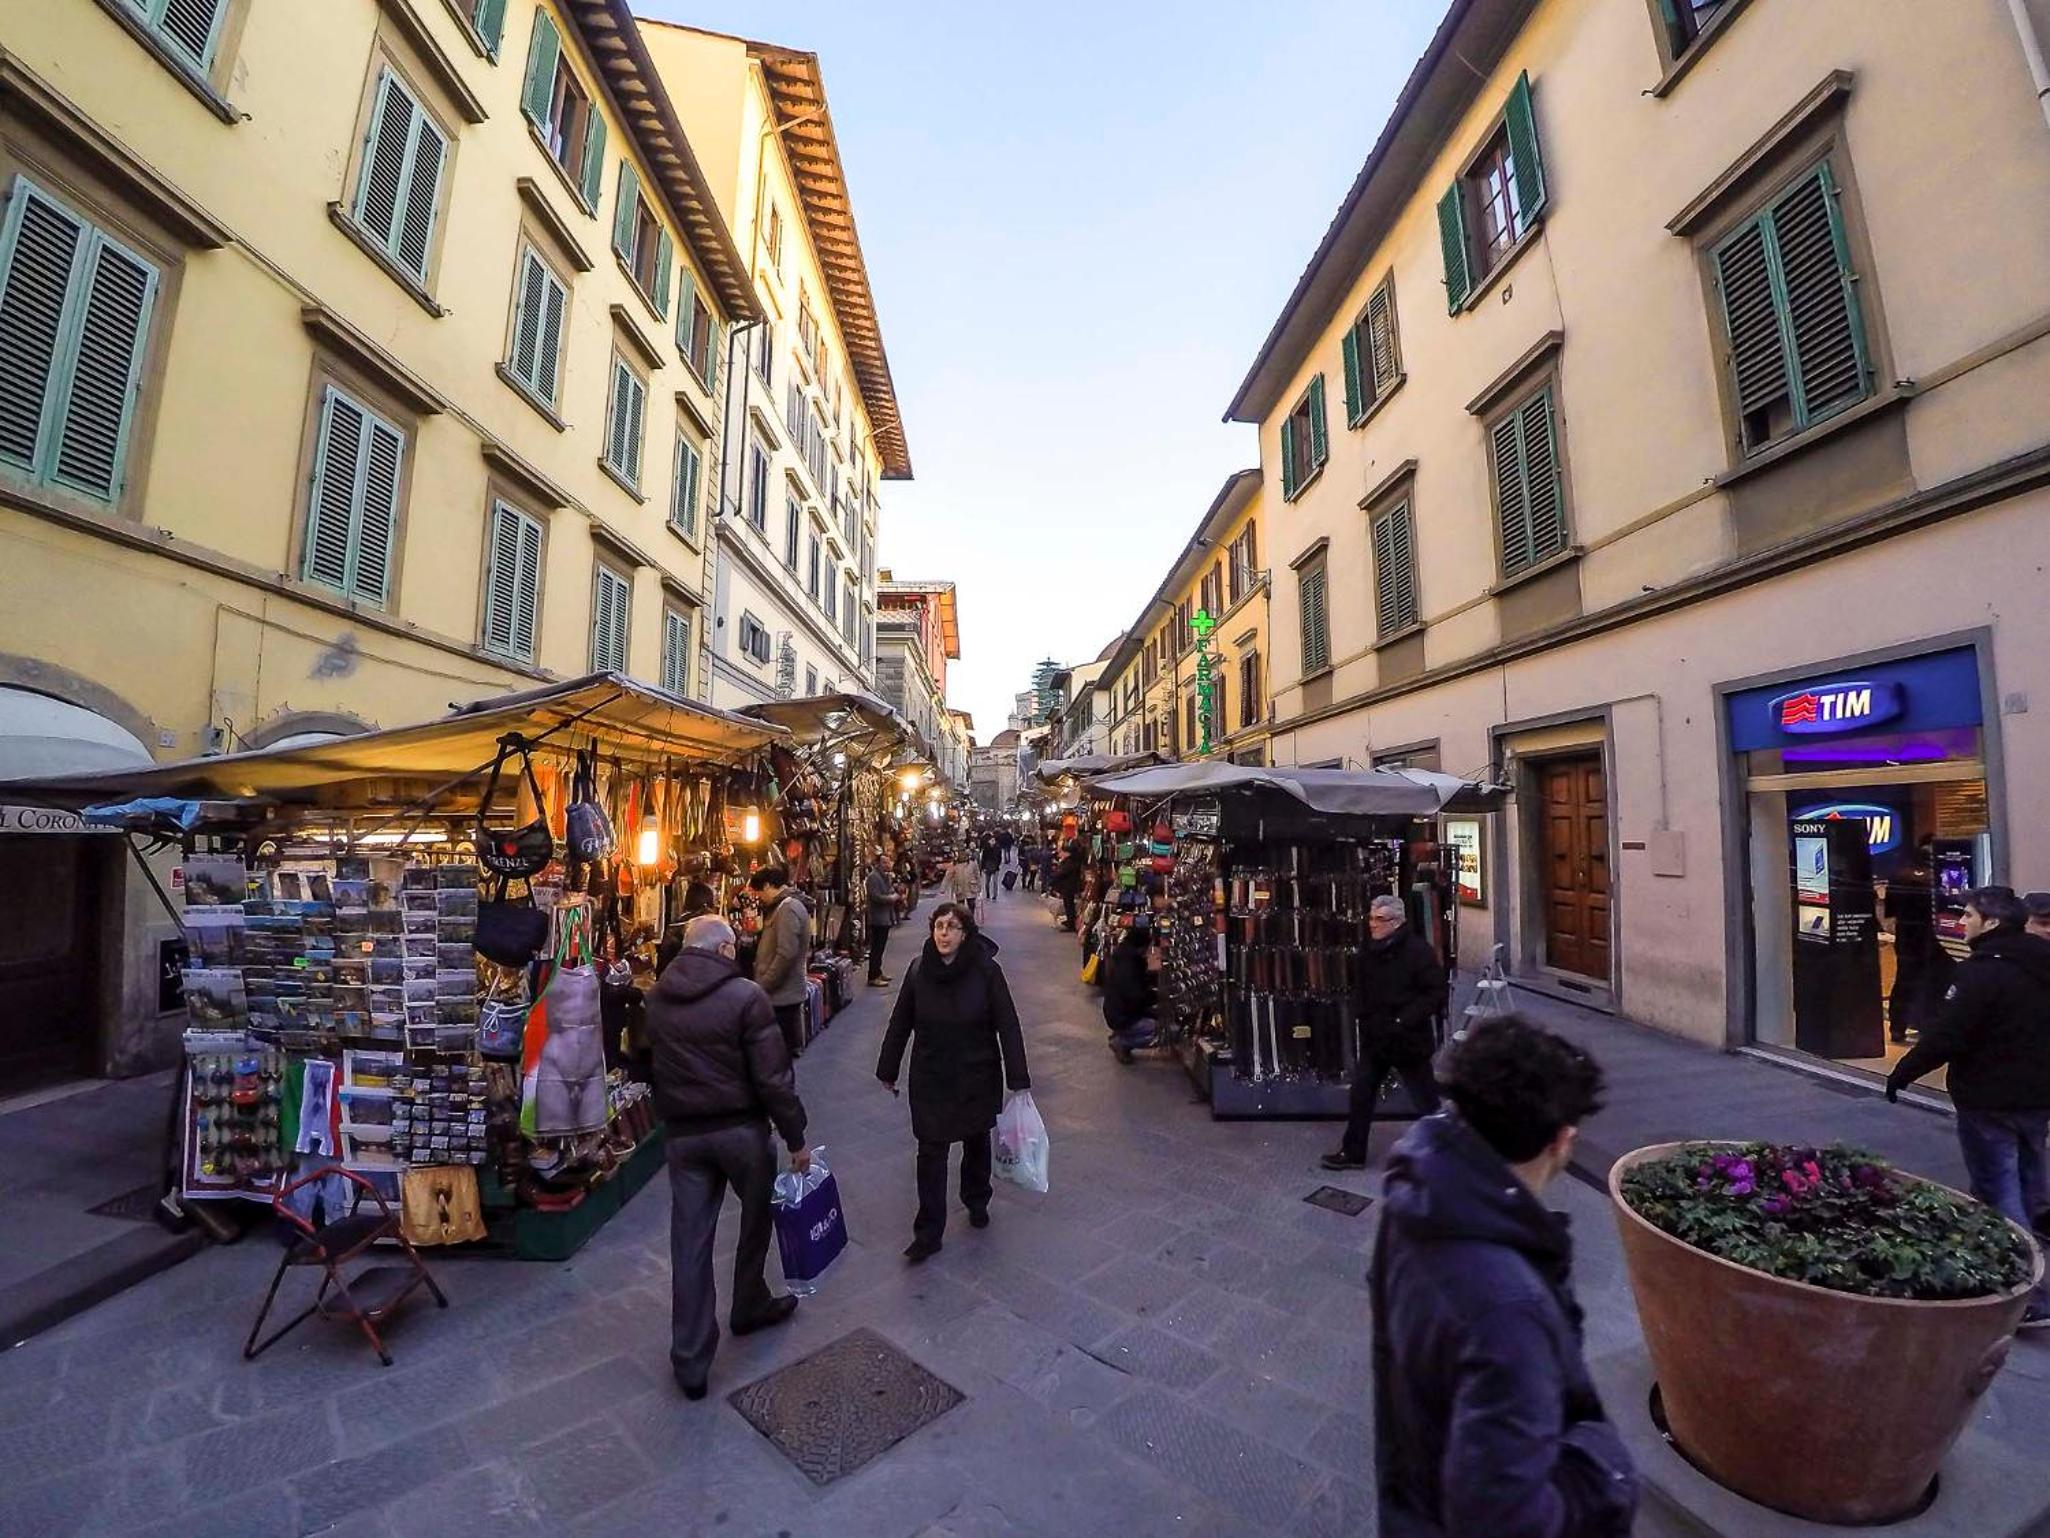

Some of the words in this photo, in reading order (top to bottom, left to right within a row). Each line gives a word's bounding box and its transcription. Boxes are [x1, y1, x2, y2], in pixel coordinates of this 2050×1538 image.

[1196, 639, 1213, 754] FARMACIA
[1820, 688, 1871, 721] TIM
[1793, 823, 1827, 834] SONY
